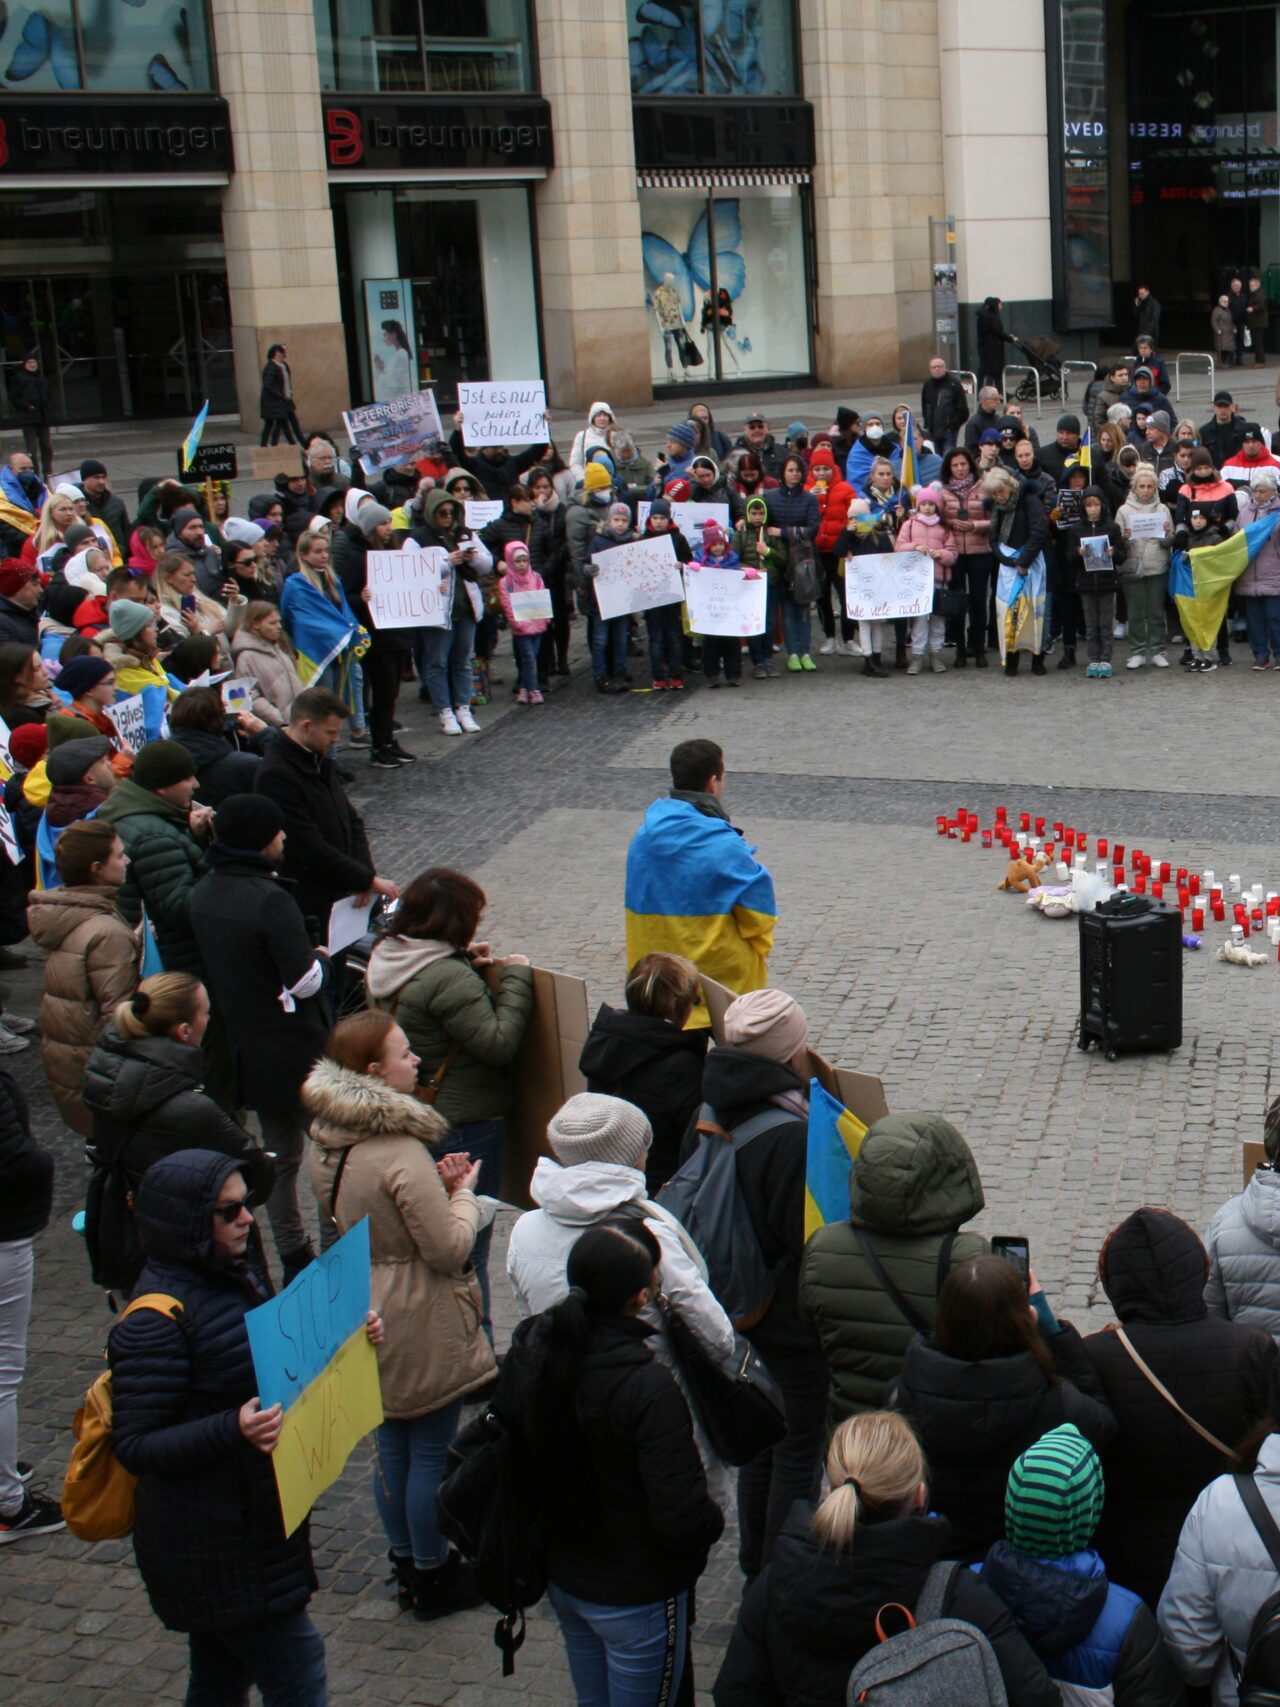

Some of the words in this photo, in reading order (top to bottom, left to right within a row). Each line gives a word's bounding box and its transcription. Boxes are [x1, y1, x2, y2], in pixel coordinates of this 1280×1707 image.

[20, 117, 225, 156] breuninger
[371, 116, 547, 153] breuninger
[363, 396, 422, 422] TERRORIST
[461, 387, 486, 405] Ist
[490, 391, 507, 404] es
[511, 389, 545, 404] nur
[373, 553, 436, 584] PUTIN
[277, 1254, 342, 1383] STOP
[294, 1368, 350, 1482] WAR
